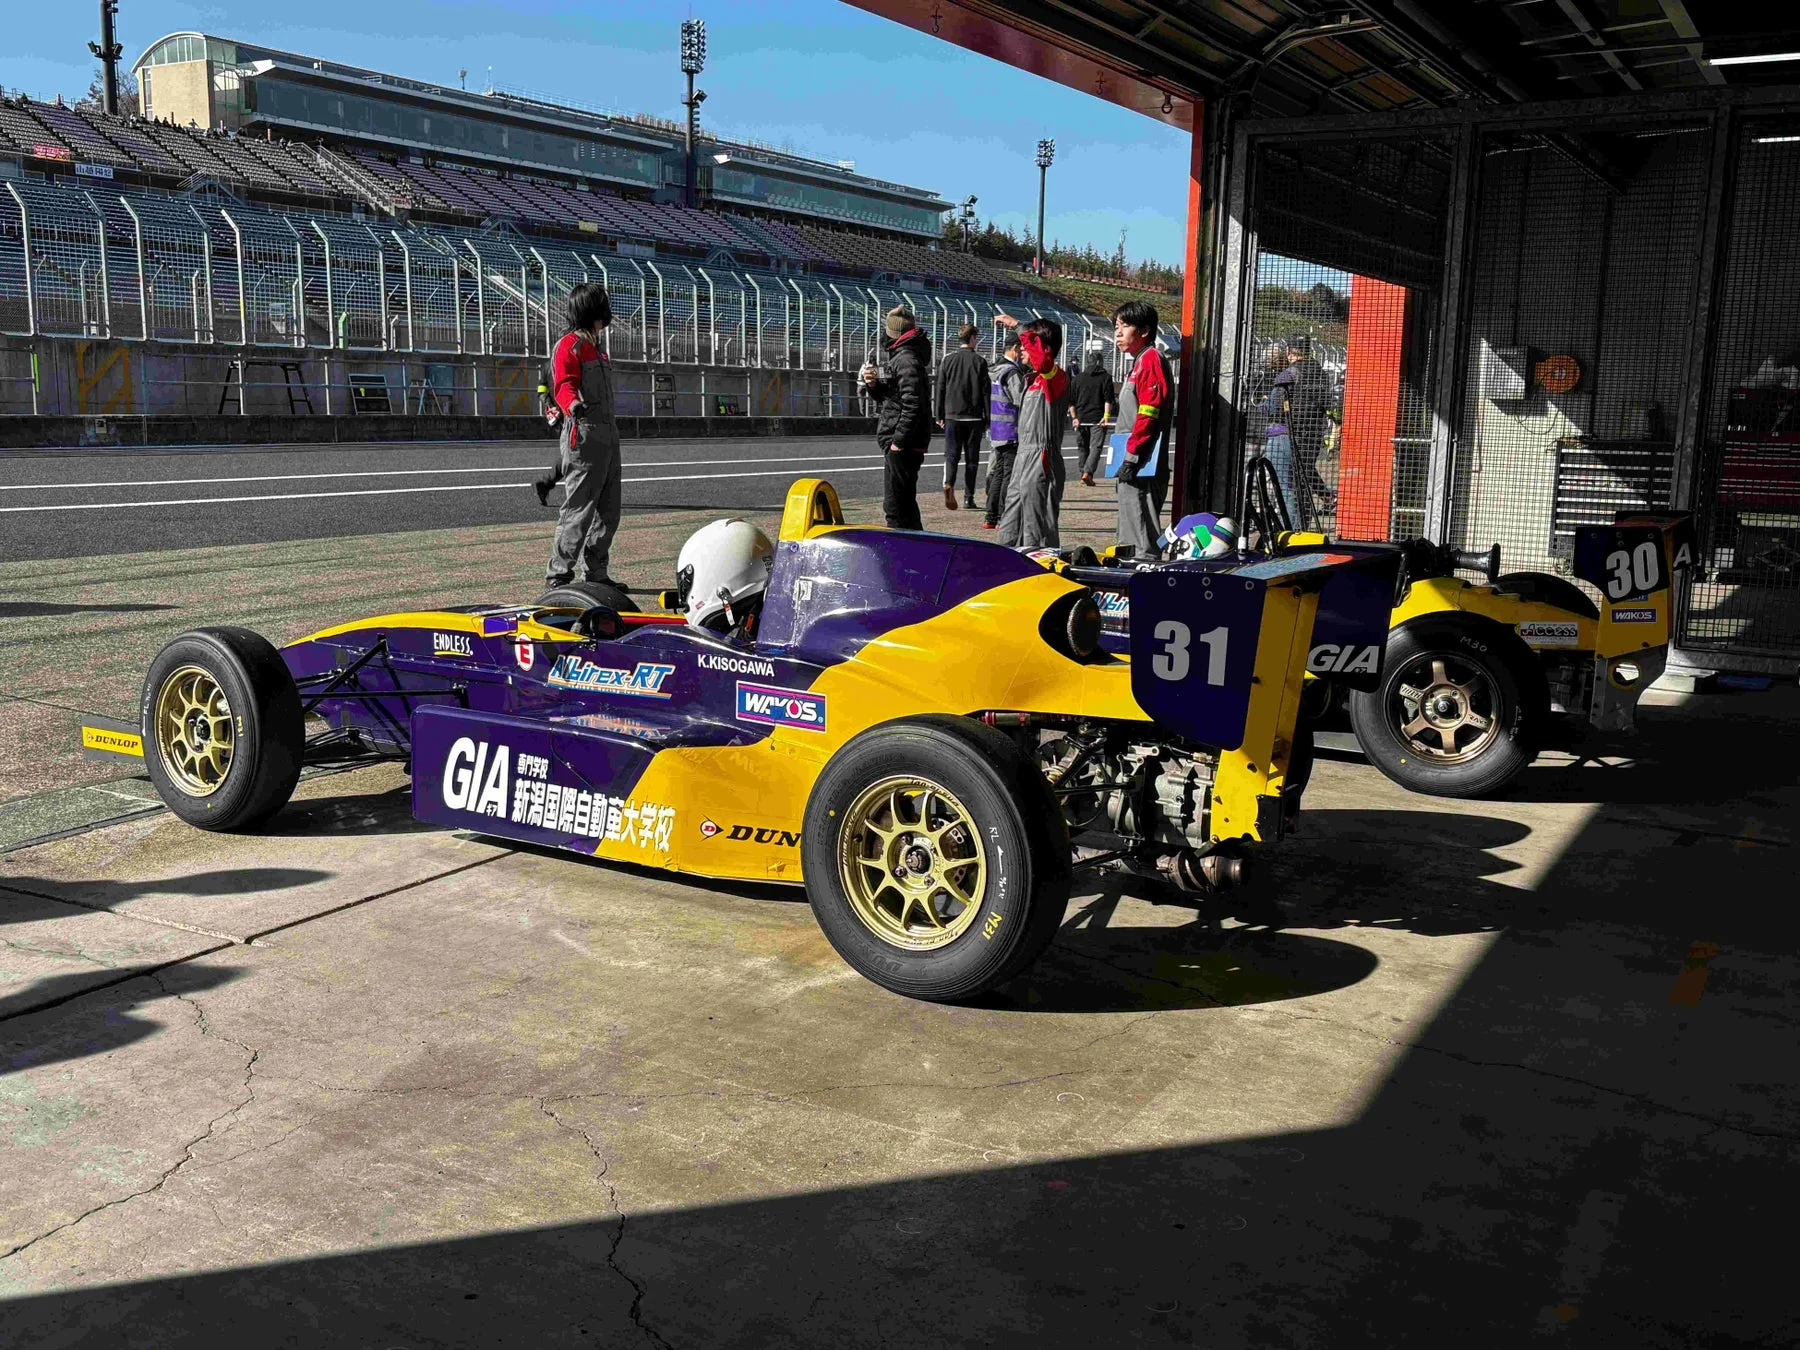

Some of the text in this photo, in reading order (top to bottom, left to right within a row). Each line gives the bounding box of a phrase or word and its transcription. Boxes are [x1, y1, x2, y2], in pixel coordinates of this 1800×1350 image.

[1605, 541, 1659, 599] 30
[433, 632, 471, 653] ENDLESS
[1151, 620, 1229, 687] 31
[697, 653, 775, 678] K.KISOGAWA
[1306, 644, 1380, 673] GIA
[94, 735, 139, 749] DUNLOP
[442, 736, 510, 819] GIA
[517, 753, 550, 780] 専門学校
[511, 778, 677, 853] 新潟国際自動車大学校
[726, 824, 802, 848] DUN
[981, 911, 1003, 942] M31
